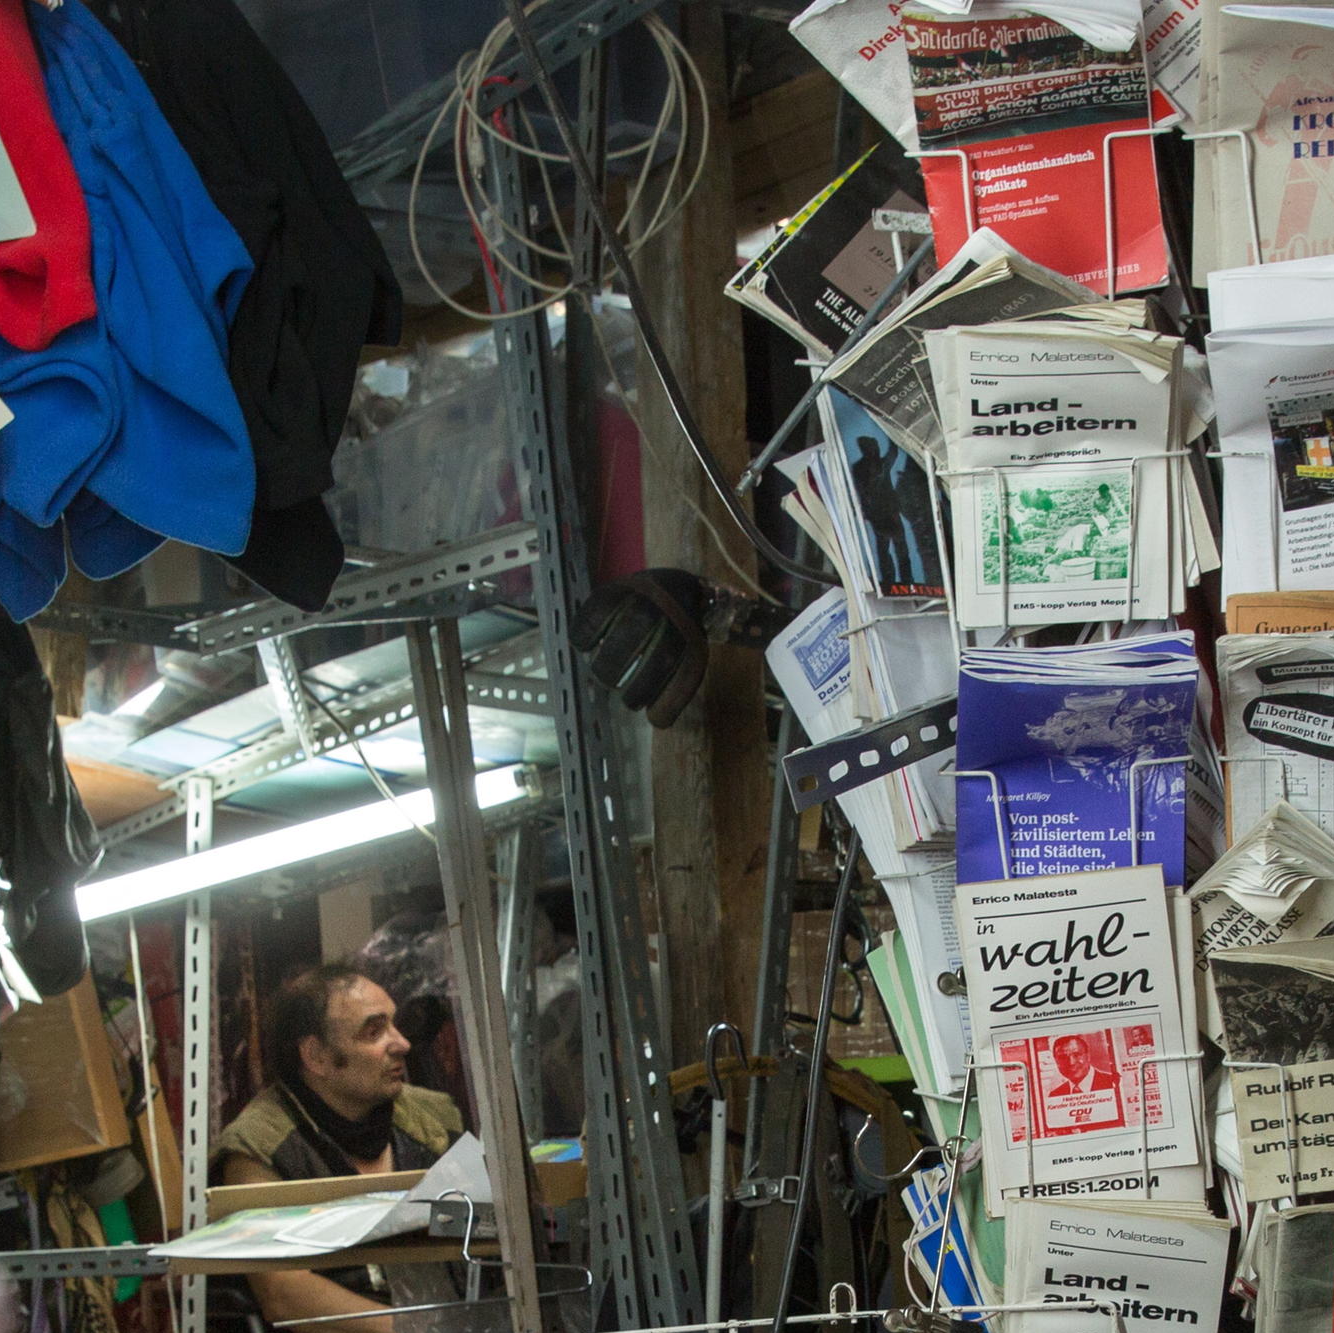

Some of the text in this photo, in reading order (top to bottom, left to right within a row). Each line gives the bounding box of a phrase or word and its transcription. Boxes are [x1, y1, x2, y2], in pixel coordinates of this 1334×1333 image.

[971, 150, 1095, 181] Organisationshandbuch
[974, 178, 1027, 197] Syndikate
[969, 350, 1115, 363] Errico Malatesta
[971, 398, 1059, 417] Land
[971, 416, 1137, 436] arbeitern
[1010, 453, 1027, 461] Ein
[1067, 599, 1097, 608] Verlag
[1256, 702, 1329, 728] Libertärer
[1253, 718, 1269, 728] ein
[1271, 719, 1315, 740] Konzept
[1317, 730, 1331, 743] für
[1010, 812, 1079, 827] Von post-
[1011, 828, 1106, 841] zivilisiertem
[1011, 845, 1106, 859] und Städten,
[1011, 861, 1079, 875] die keine
[972, 887, 1077, 906] Errico Malatesta
[977, 921, 995, 936] in
[989, 966, 1154, 1012] zeiten
[1069, 1107, 1092, 1117] CDU
[1105, 1147, 1134, 1158] Verlag
[1049, 1220, 1185, 1248] Errico Malatesta
[1047, 1247, 1075, 1258] Unter
[1045, 1268, 1127, 1290] Land
